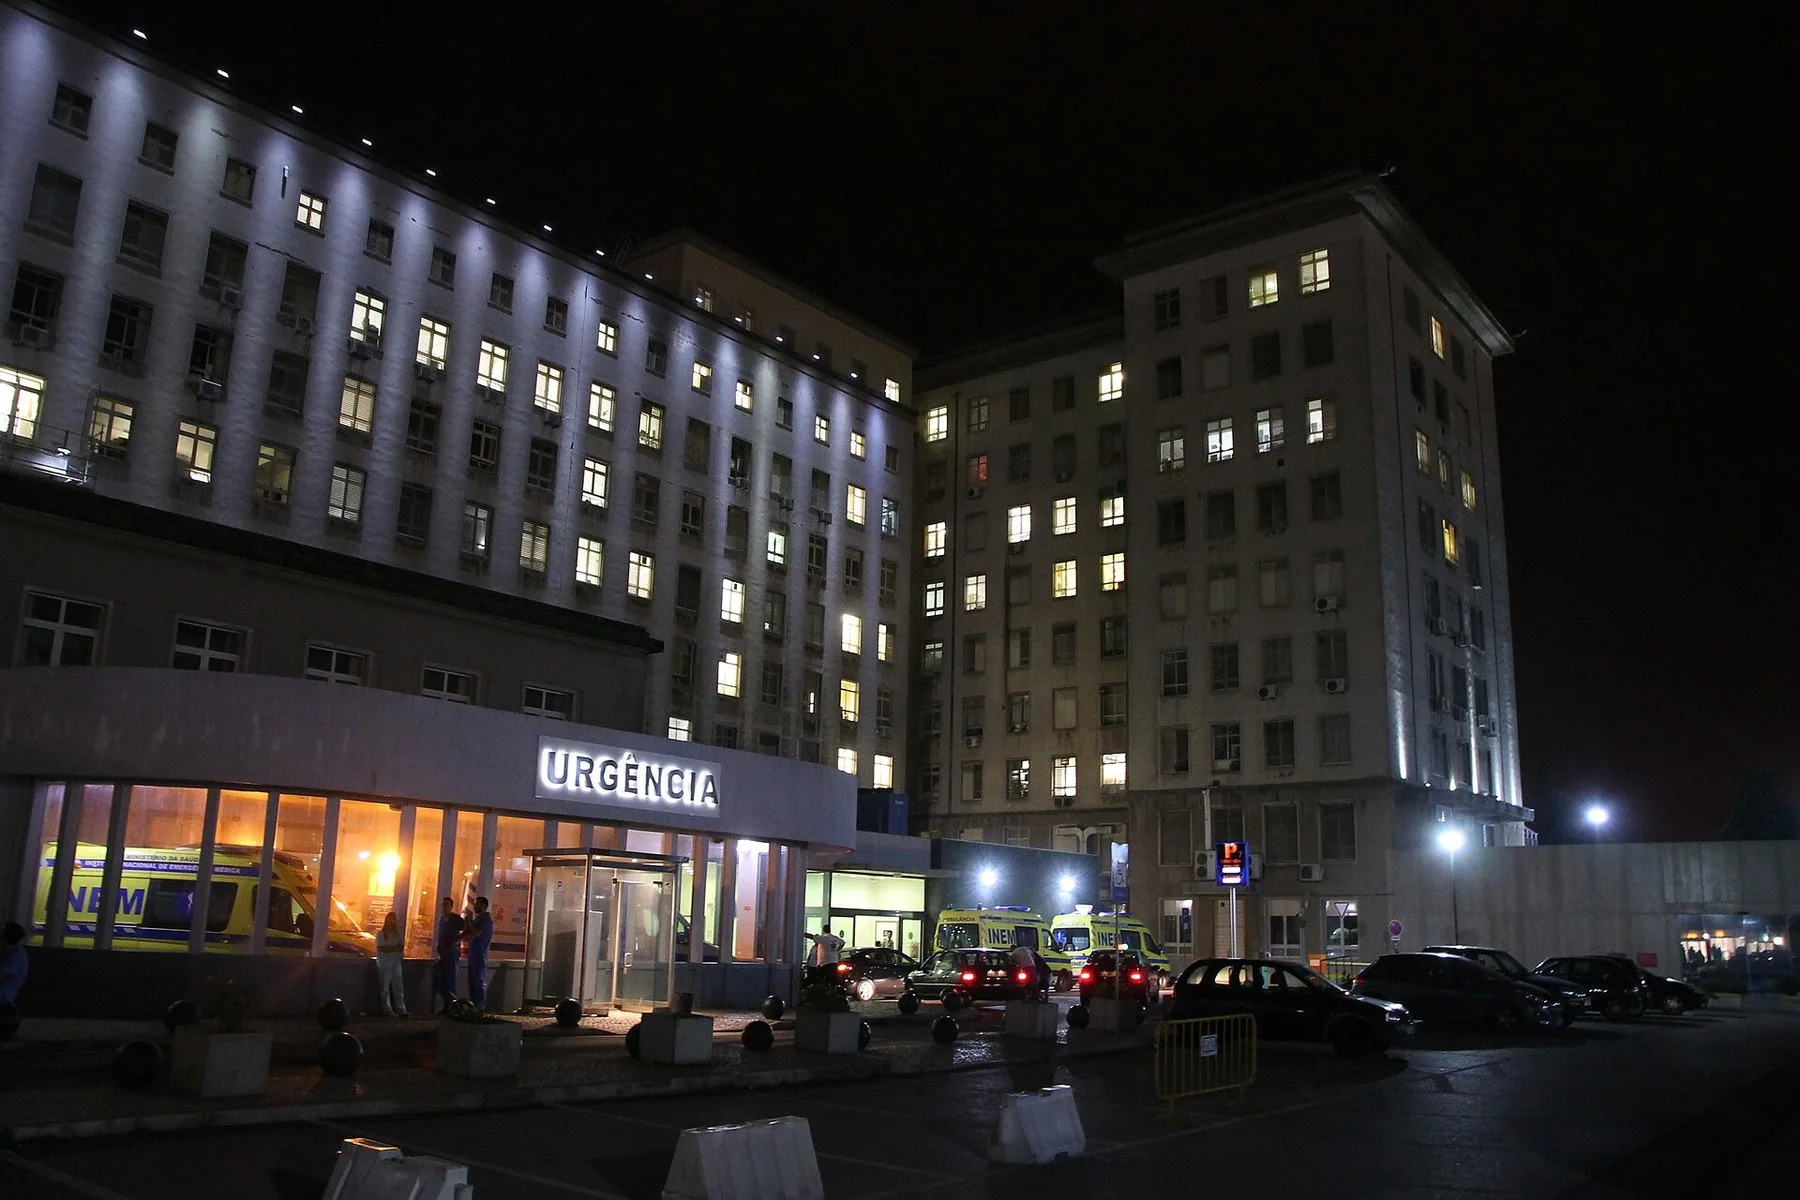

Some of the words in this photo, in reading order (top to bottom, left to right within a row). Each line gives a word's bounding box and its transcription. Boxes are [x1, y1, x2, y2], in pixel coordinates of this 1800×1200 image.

[546, 751, 719, 805] URGÊNCIA
[1224, 843, 1237, 858] P
[122, 861, 157, 869] NACIONAL
[988, 928, 1016, 944] INEM
[1097, 932, 1116, 946] INE
